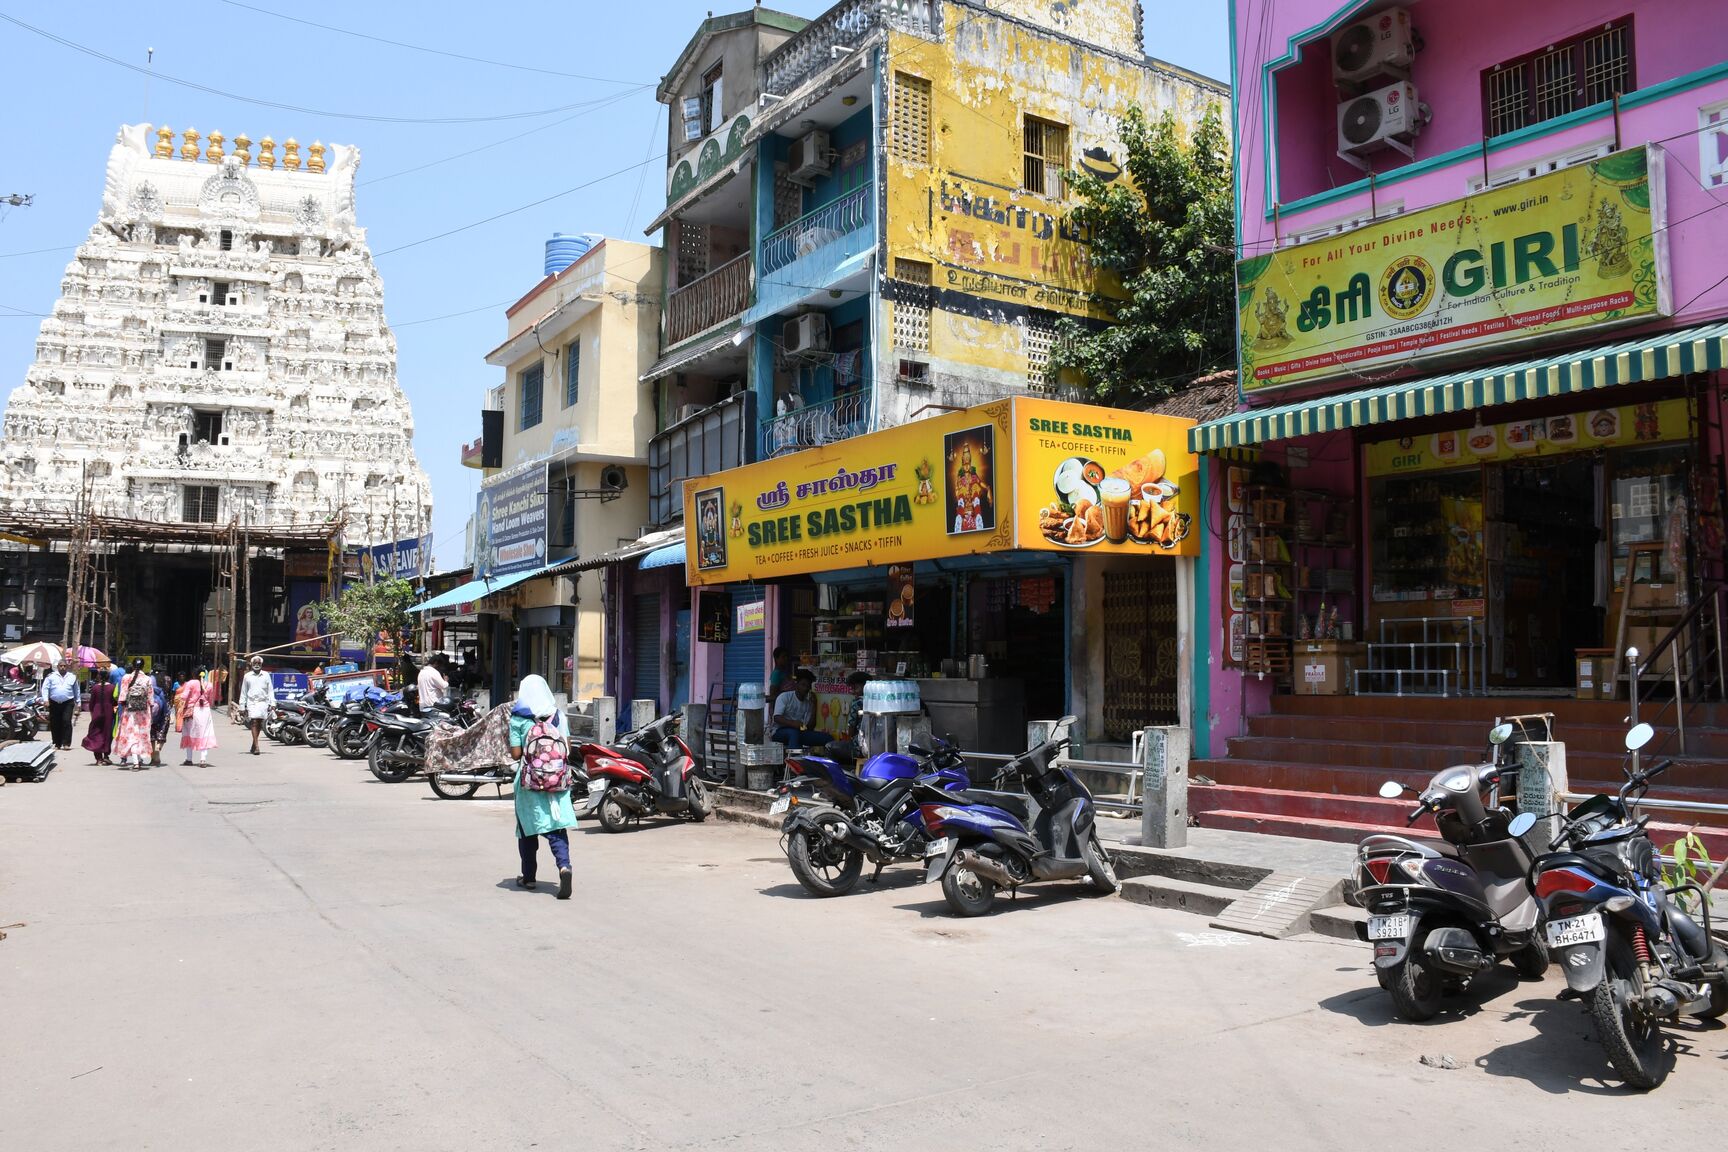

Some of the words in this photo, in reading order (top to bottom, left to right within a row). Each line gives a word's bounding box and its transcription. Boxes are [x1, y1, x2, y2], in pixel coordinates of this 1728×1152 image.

[1380, 31, 1391, 40] LG
[1388, 105, 1400, 115] LG
[1302, 255, 1321, 268] For
[1326, 249, 1343, 262] All
[1348, 241, 1376, 256] Your
[1382, 227, 1424, 247] Divine
[1493, 194, 1549, 217] www.giri.in
[1442, 222, 1580, 298] GIRI
[1296, 272, 1372, 334] கிரி
[1447, 301, 1462, 310] For
[1463, 294, 1491, 307] Indian
[1528, 283, 1536, 292] &
[1538, 275, 1581, 290] Tradition
[1257, 368, 1270, 377] Books
[1274, 364, 1287, 373] Music
[1290, 360, 1301, 370] Gifts
[1305, 358, 1319, 367] Divine
[1319, 355, 1332, 364] Items
[1336, 349, 1363, 361] Handicrafts
[1367, 345, 1381, 355] Pooja
[1381, 343, 1396, 352] Items
[1400, 338, 1418, 348] Temple
[1439, 329, 1460, 341] Festival
[1461, 325, 1478, 336] Needs
[1483, 320, 1505, 332] Textiles
[1566, 299, 1608, 315] Multi-purpose
[1609, 295, 1629, 306] Racks
[1366, 330, 1388, 341] GSTIN:
[1029, 417, 1069, 435] SREE
[1072, 422, 1133, 442] SASTHA
[1039, 438, 1056, 449] TEA
[1061, 441, 1094, 453] COFFEE
[1099, 445, 1126, 456] TIFFIN
[1391, 453, 1421, 468] GIRI
[796, 463, 897, 500] சாஸ்தா
[491, 504, 510, 521] Shree
[509, 495, 530, 515] Kanchi
[529, 491, 545, 508] Silks
[491, 518, 506, 535] Hand
[505, 513, 520, 530] Loom
[520, 508, 545, 525] Weavers
[747, 516, 802, 547] SREE
[806, 493, 913, 538] SASTHA
[755, 554, 767, 566] TEA
[770, 550, 794, 564] COFFEE
[798, 547, 819, 560] FRESH
[820, 544, 839, 558] JUICE
[844, 540, 872, 554] SNACKS
[878, 535, 902, 548] TIFFIN
[1376, 928, 1403, 938] S9231
[1555, 930, 1596, 945] BH-6471
[1557, 918, 1586, 931] TN-21
